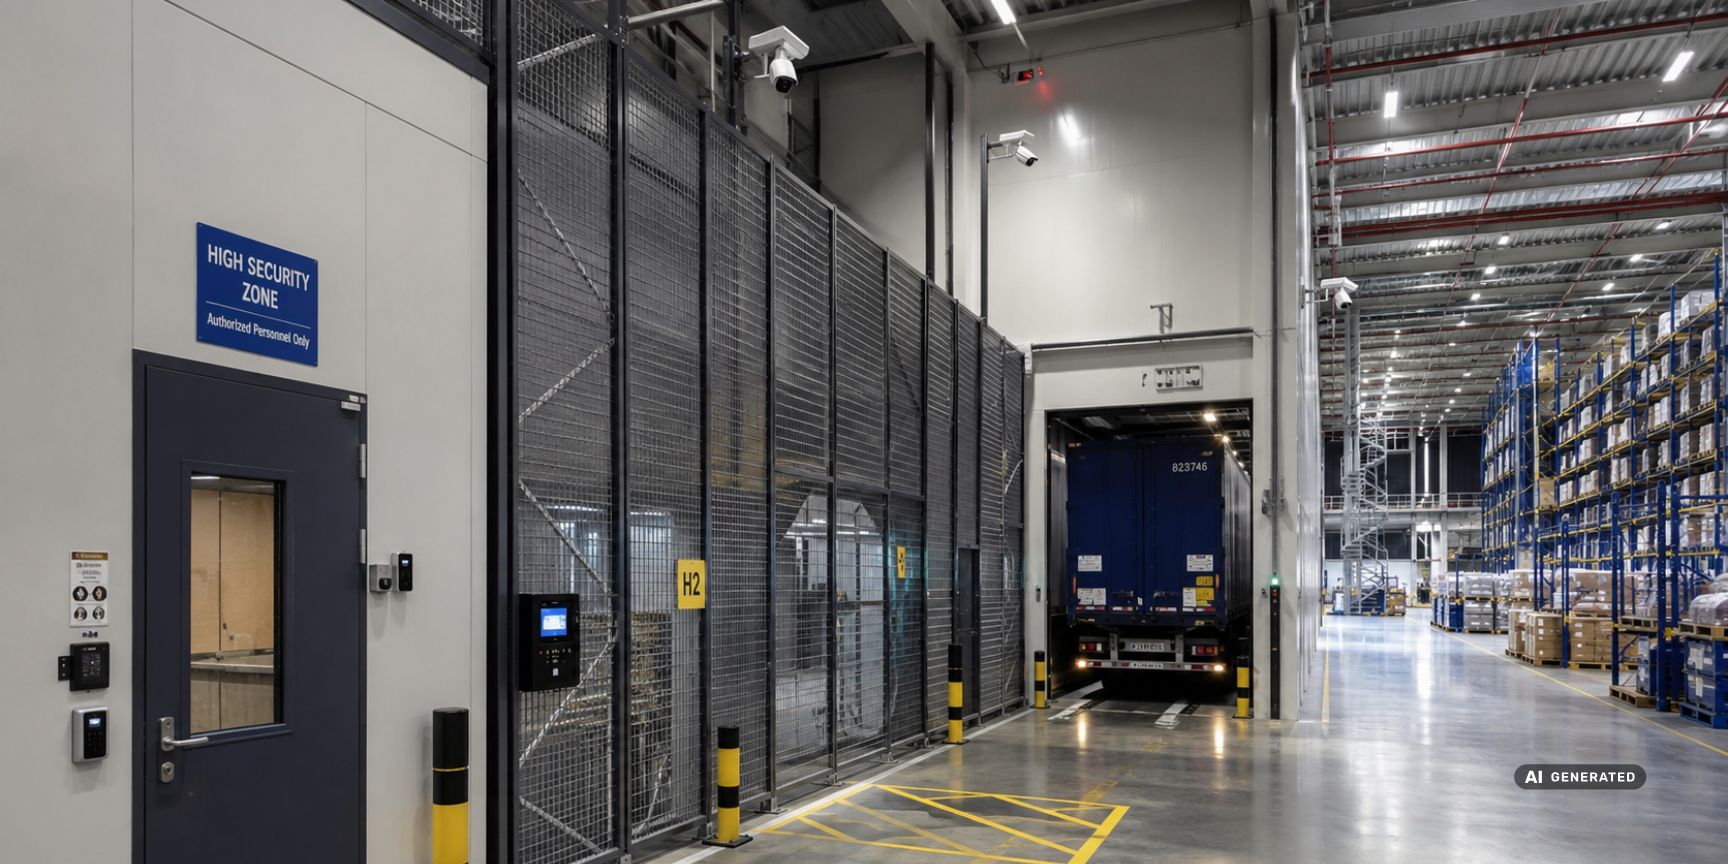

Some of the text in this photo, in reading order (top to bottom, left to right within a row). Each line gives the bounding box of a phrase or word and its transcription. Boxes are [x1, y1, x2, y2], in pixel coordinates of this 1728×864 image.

[208, 244, 310, 291] HIGH SECURITY
[242, 282, 278, 309] ZONE
[207, 312, 310, 350] Authorized Personnel Only
[1172, 461, 1208, 473] 823746
[683, 571, 700, 596] H2
